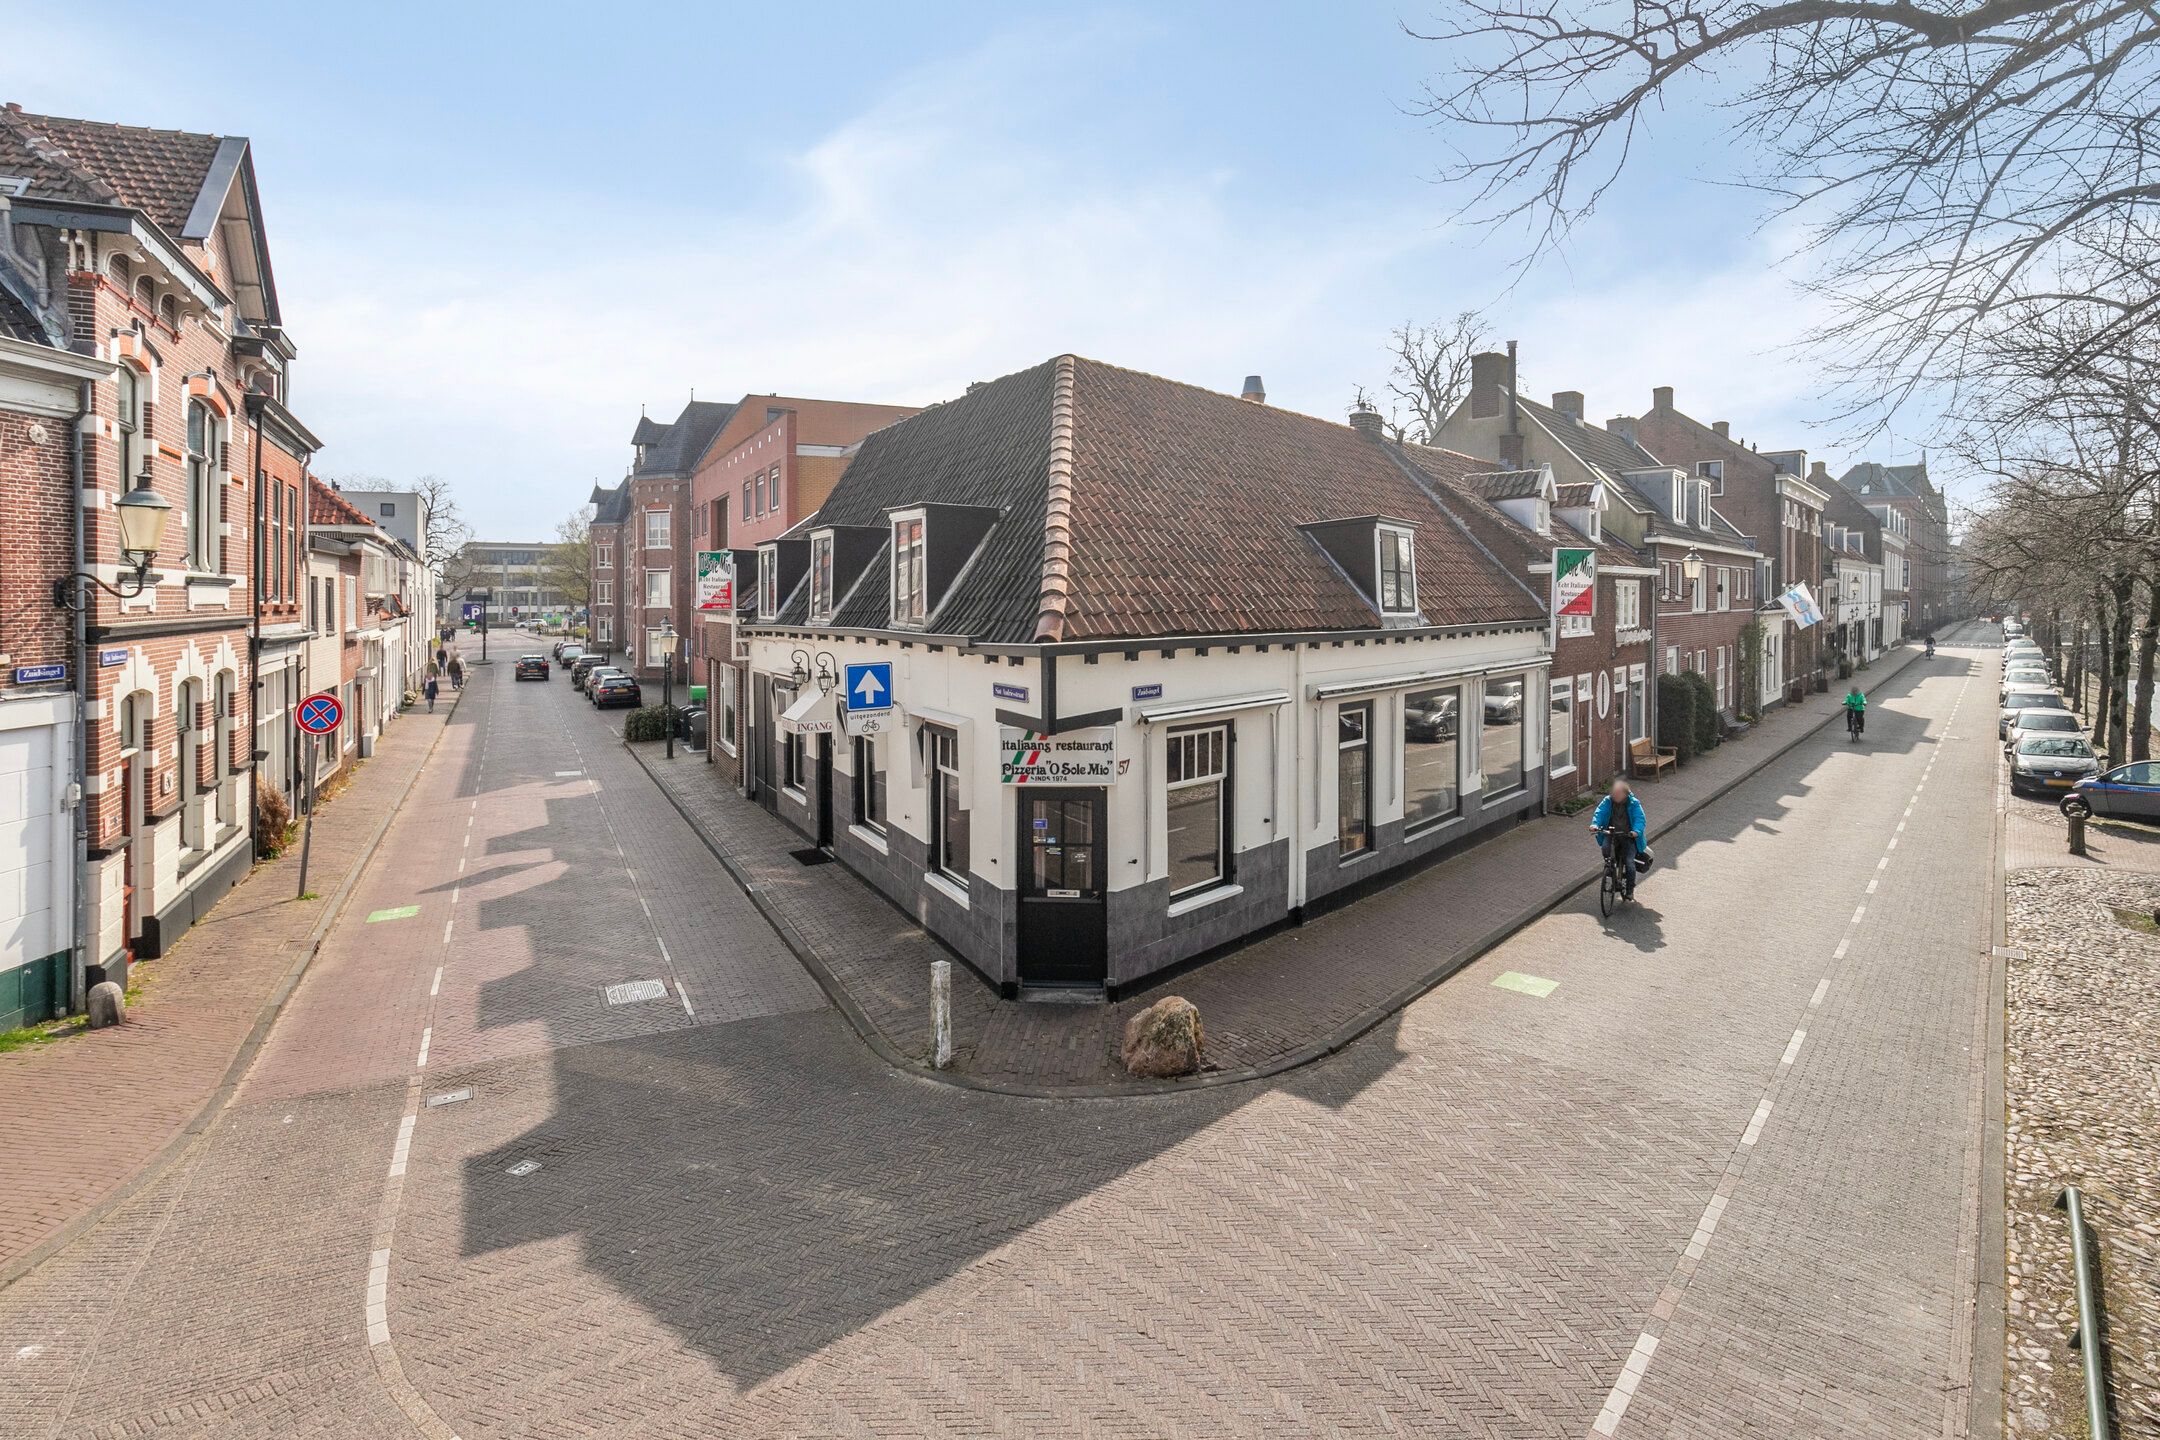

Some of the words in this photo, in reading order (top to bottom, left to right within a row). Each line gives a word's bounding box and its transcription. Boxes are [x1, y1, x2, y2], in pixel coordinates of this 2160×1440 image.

[1580, 555, 1593, 579] Mio
[471, 606, 481, 620] P
[23, 668, 61, 678] Zuidsingel
[850, 711, 891, 720] uitgezonderd
[797, 721, 832, 732] INGANG
[1002, 739, 1051, 753] italiaans
[1056, 740, 1113, 753] restaurant
[1001, 763, 1047, 775] Pizzeria
[1062, 762, 1086, 775] Sole
[1118, 758, 1131, 775] 57
